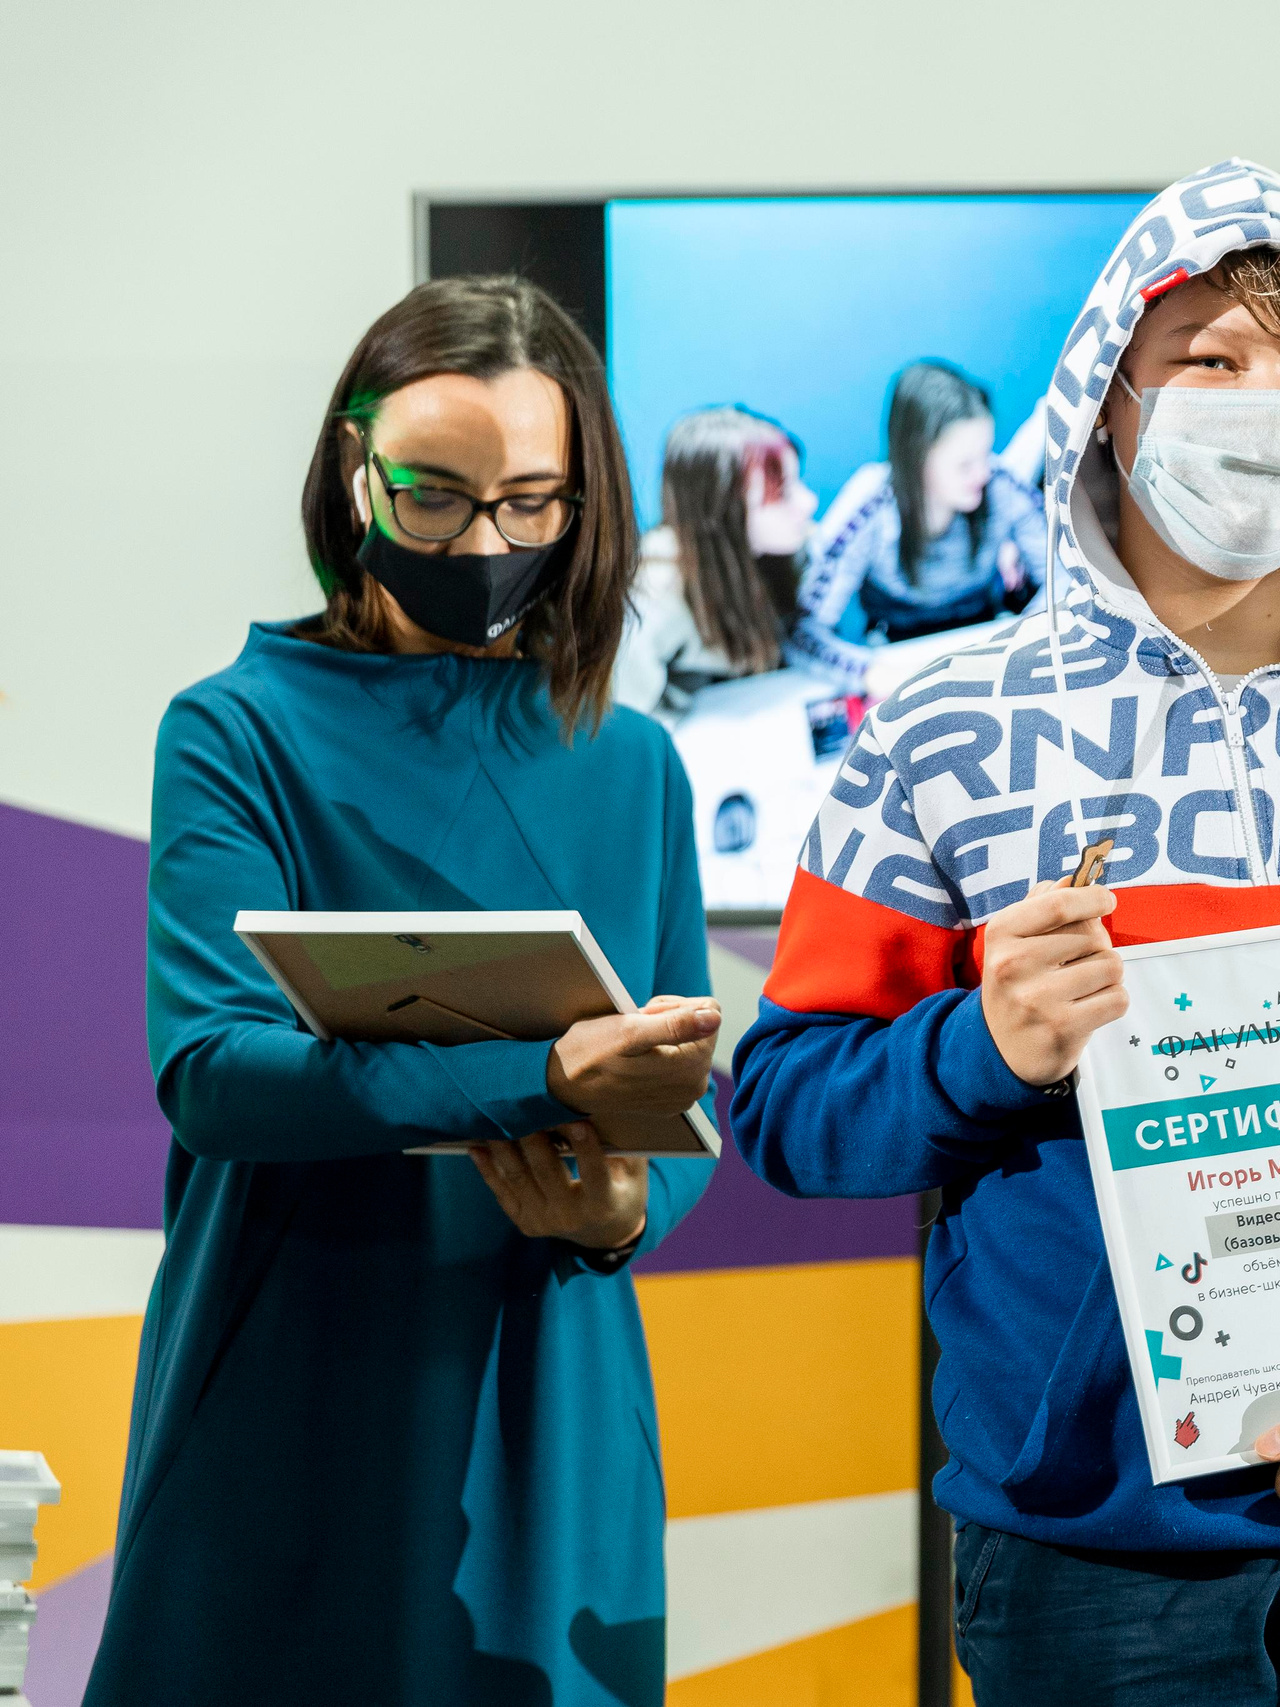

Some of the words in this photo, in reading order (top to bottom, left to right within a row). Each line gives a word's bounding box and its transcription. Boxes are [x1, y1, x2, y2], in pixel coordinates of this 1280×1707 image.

[1187, 1166, 1262, 1192] Игорь
[1213, 1191, 1271, 1212] успешно
[1198, 1292, 1206, 1302] в
[1186, 1367, 1260, 1386] Преподаватель
[1190, 1386, 1240, 1405] Андрей
